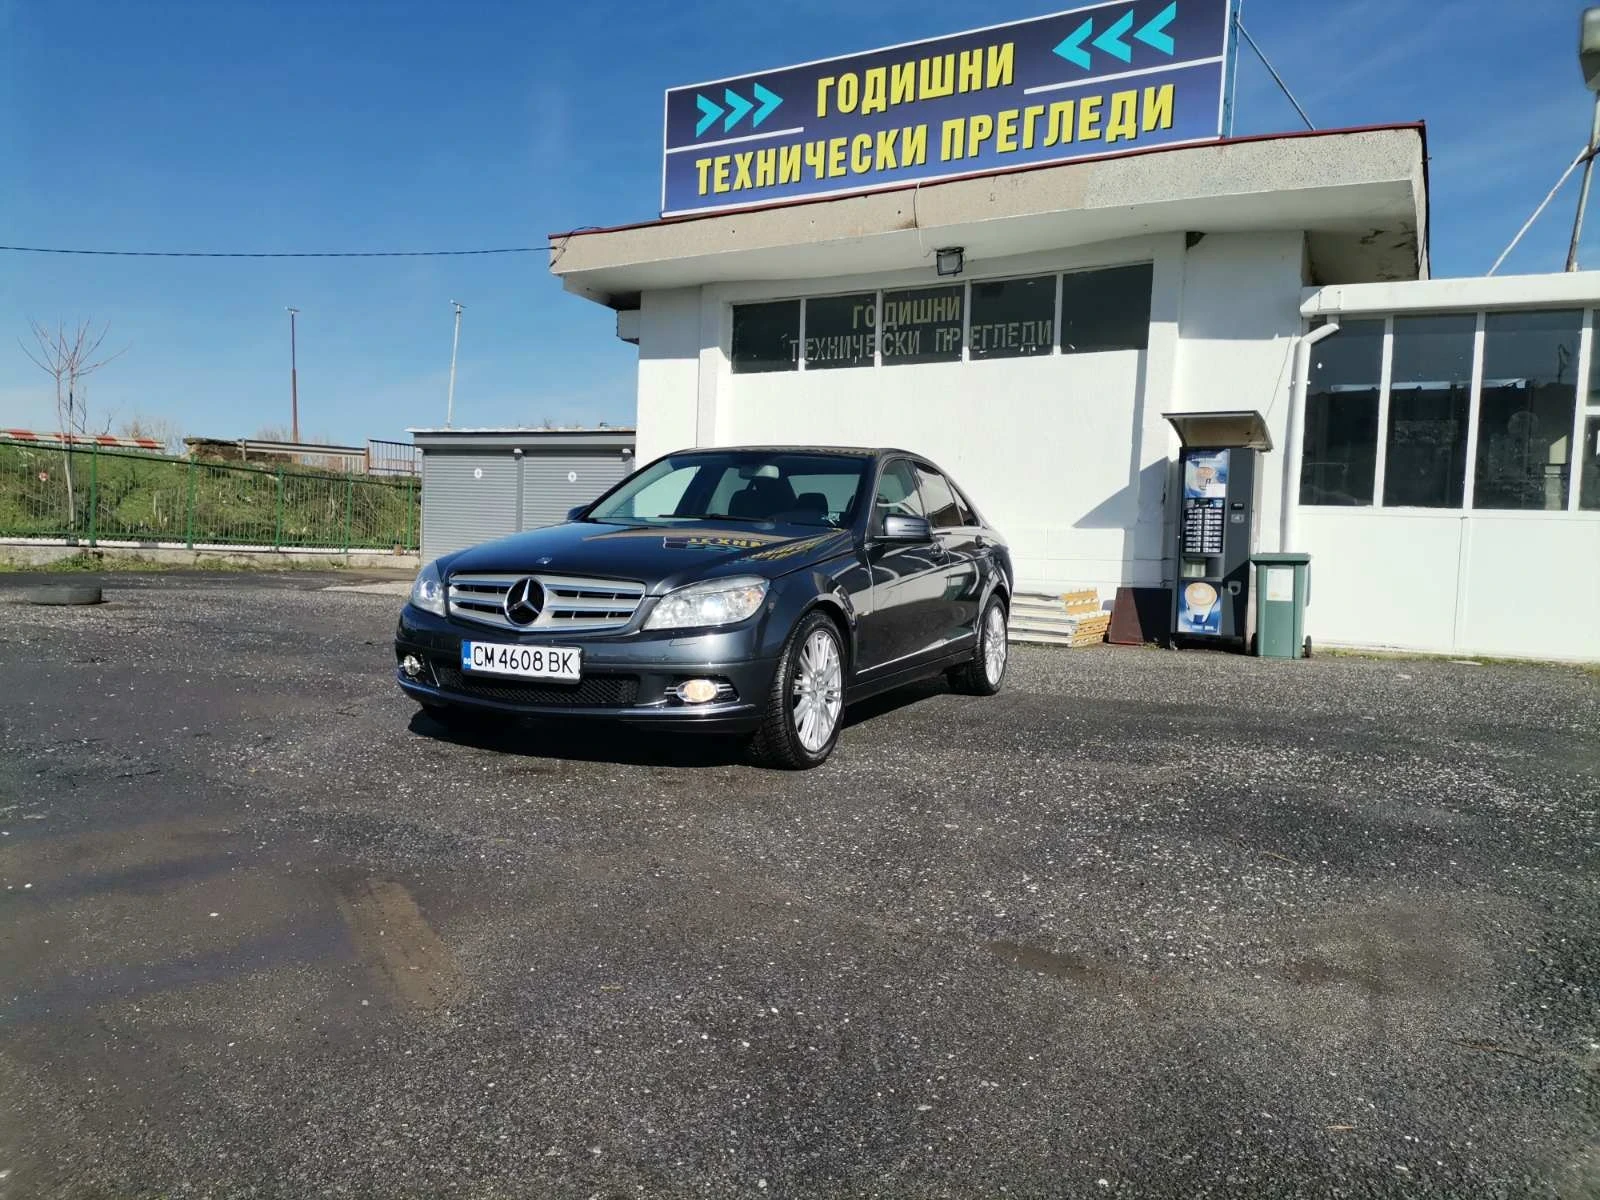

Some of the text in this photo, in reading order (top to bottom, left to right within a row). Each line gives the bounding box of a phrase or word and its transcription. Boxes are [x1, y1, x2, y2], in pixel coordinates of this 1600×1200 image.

[817, 42, 1015, 118] ГОДИШНИ
[696, 84, 1175, 196] ТЕХНИЧЕСКИ ПРЕГЛЕДИ
[853, 296, 960, 330] ГОДИШНИ
[789, 330, 921, 362] ТЕХНИЧЕСКИ
